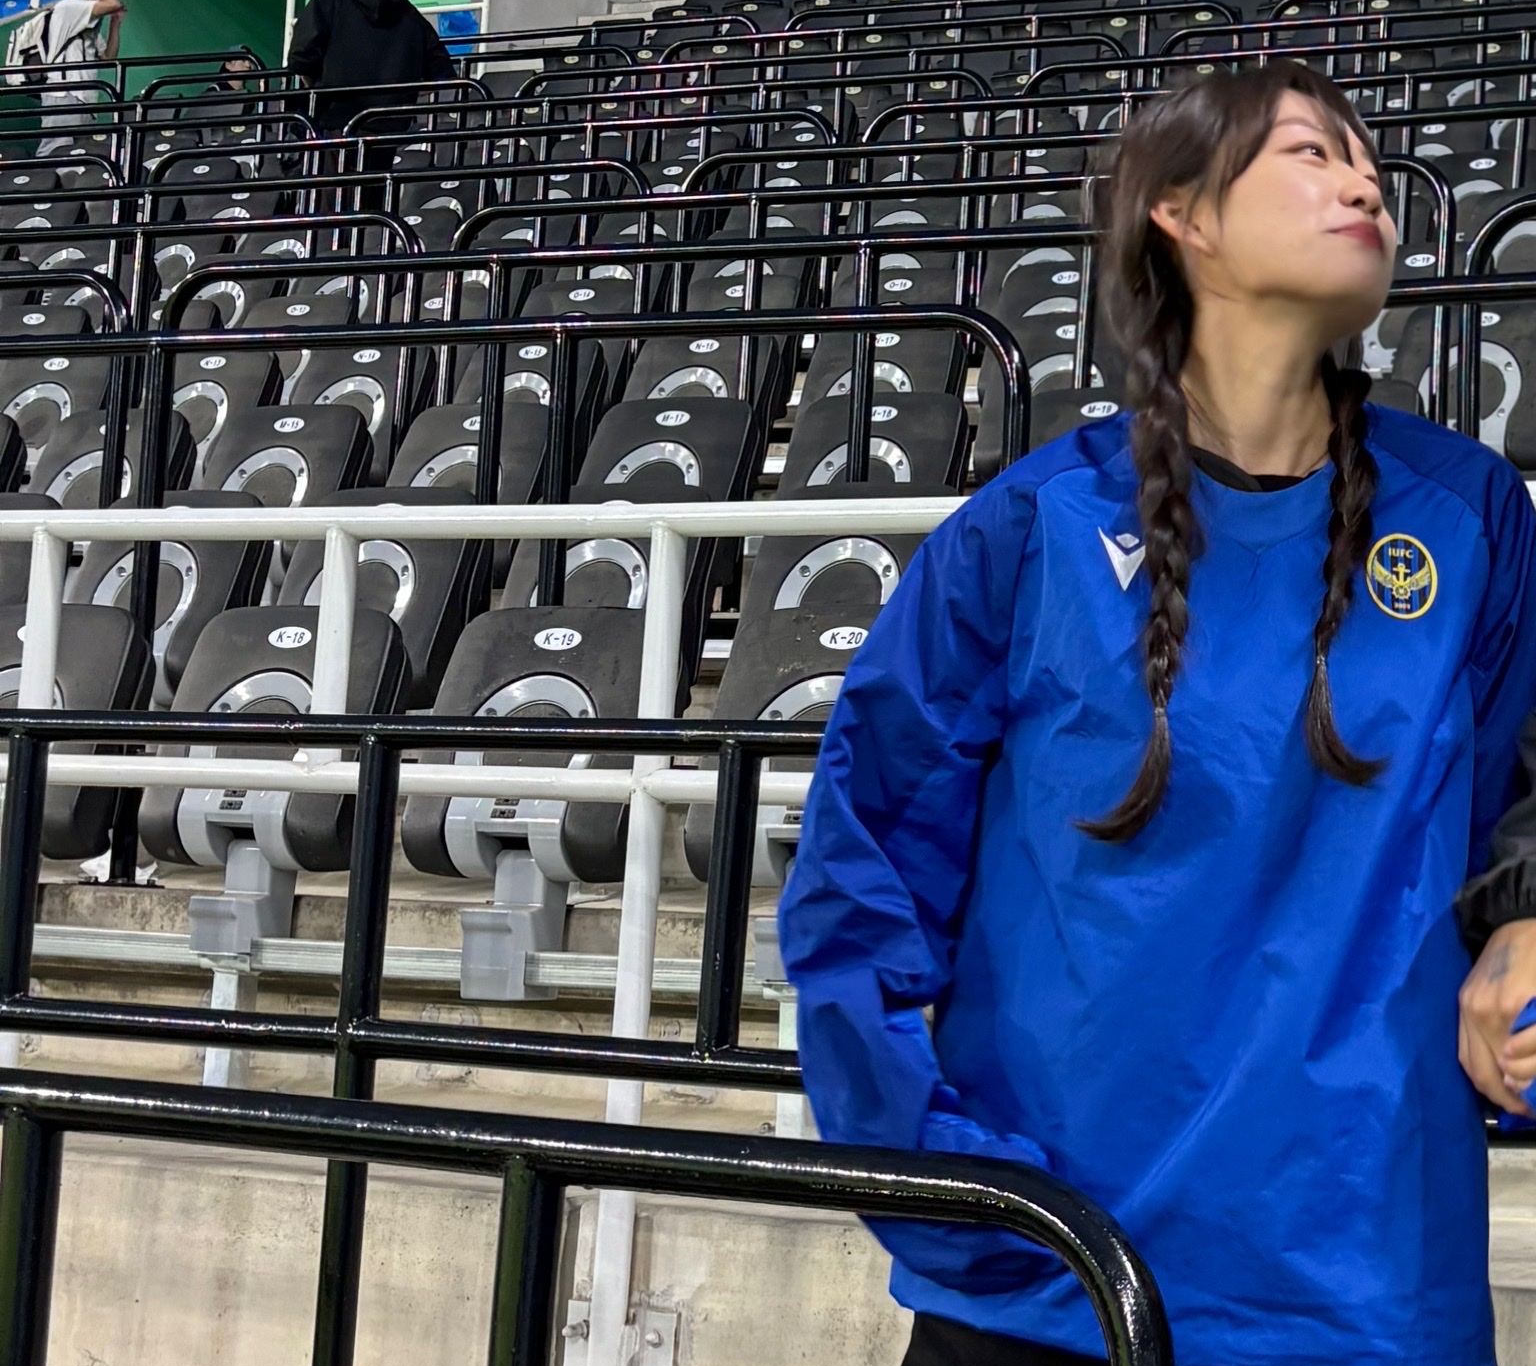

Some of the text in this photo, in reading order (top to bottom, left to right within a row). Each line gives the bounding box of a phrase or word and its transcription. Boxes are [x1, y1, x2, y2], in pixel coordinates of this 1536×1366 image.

[1388, 547, 1414, 559] IUFC
[275, 630, 306, 645] K-18
[542, 632, 575, 647] K-19
[828, 631, 864, 646] K-20
